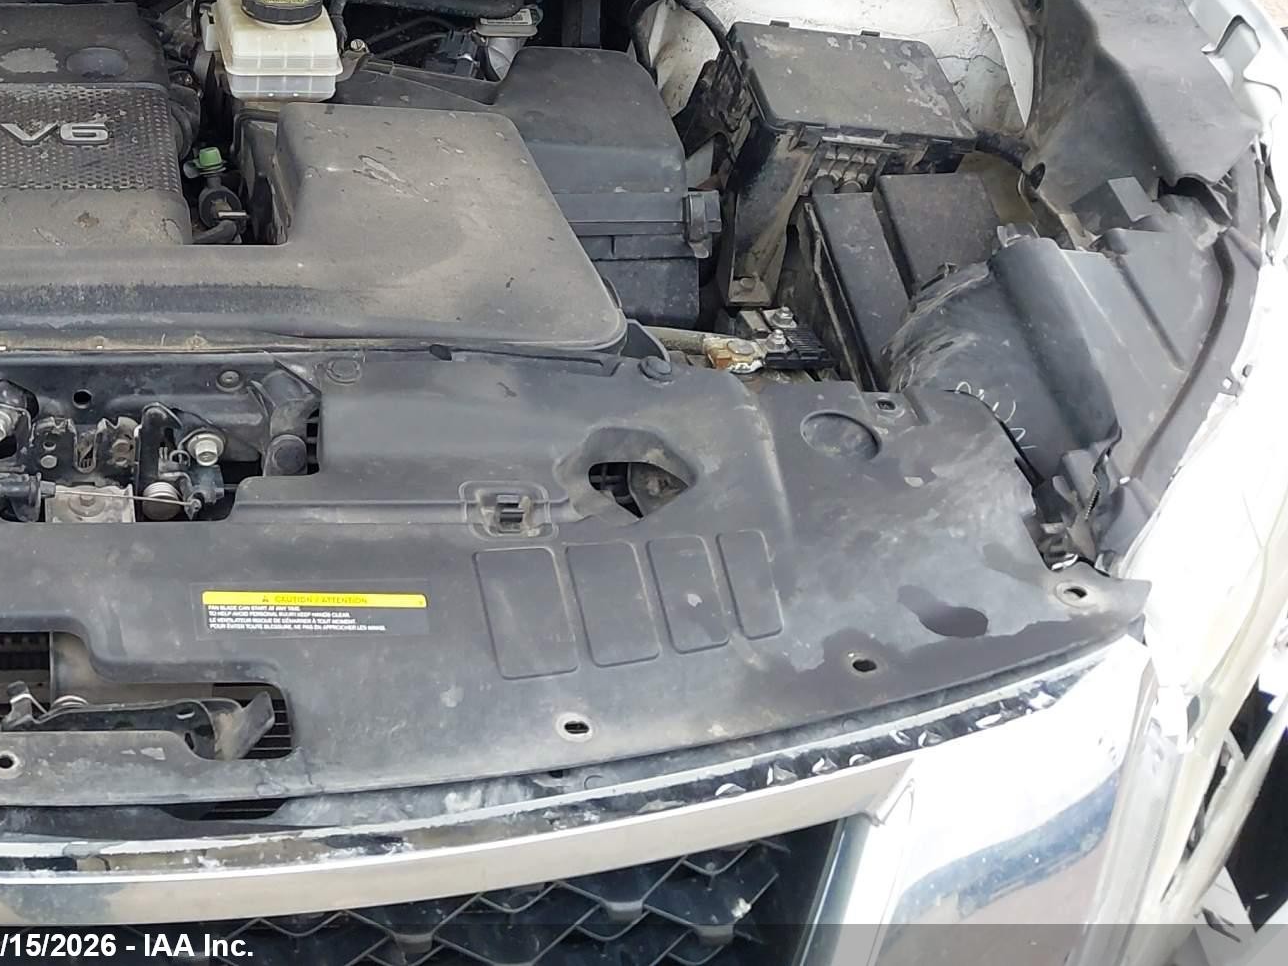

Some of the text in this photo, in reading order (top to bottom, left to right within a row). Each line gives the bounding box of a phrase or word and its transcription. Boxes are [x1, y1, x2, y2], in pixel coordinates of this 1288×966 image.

[0, 122, 109, 145] V6
[275, 595, 312, 603] CAUTION
[322, 596, 368, 604] ATTENTION
